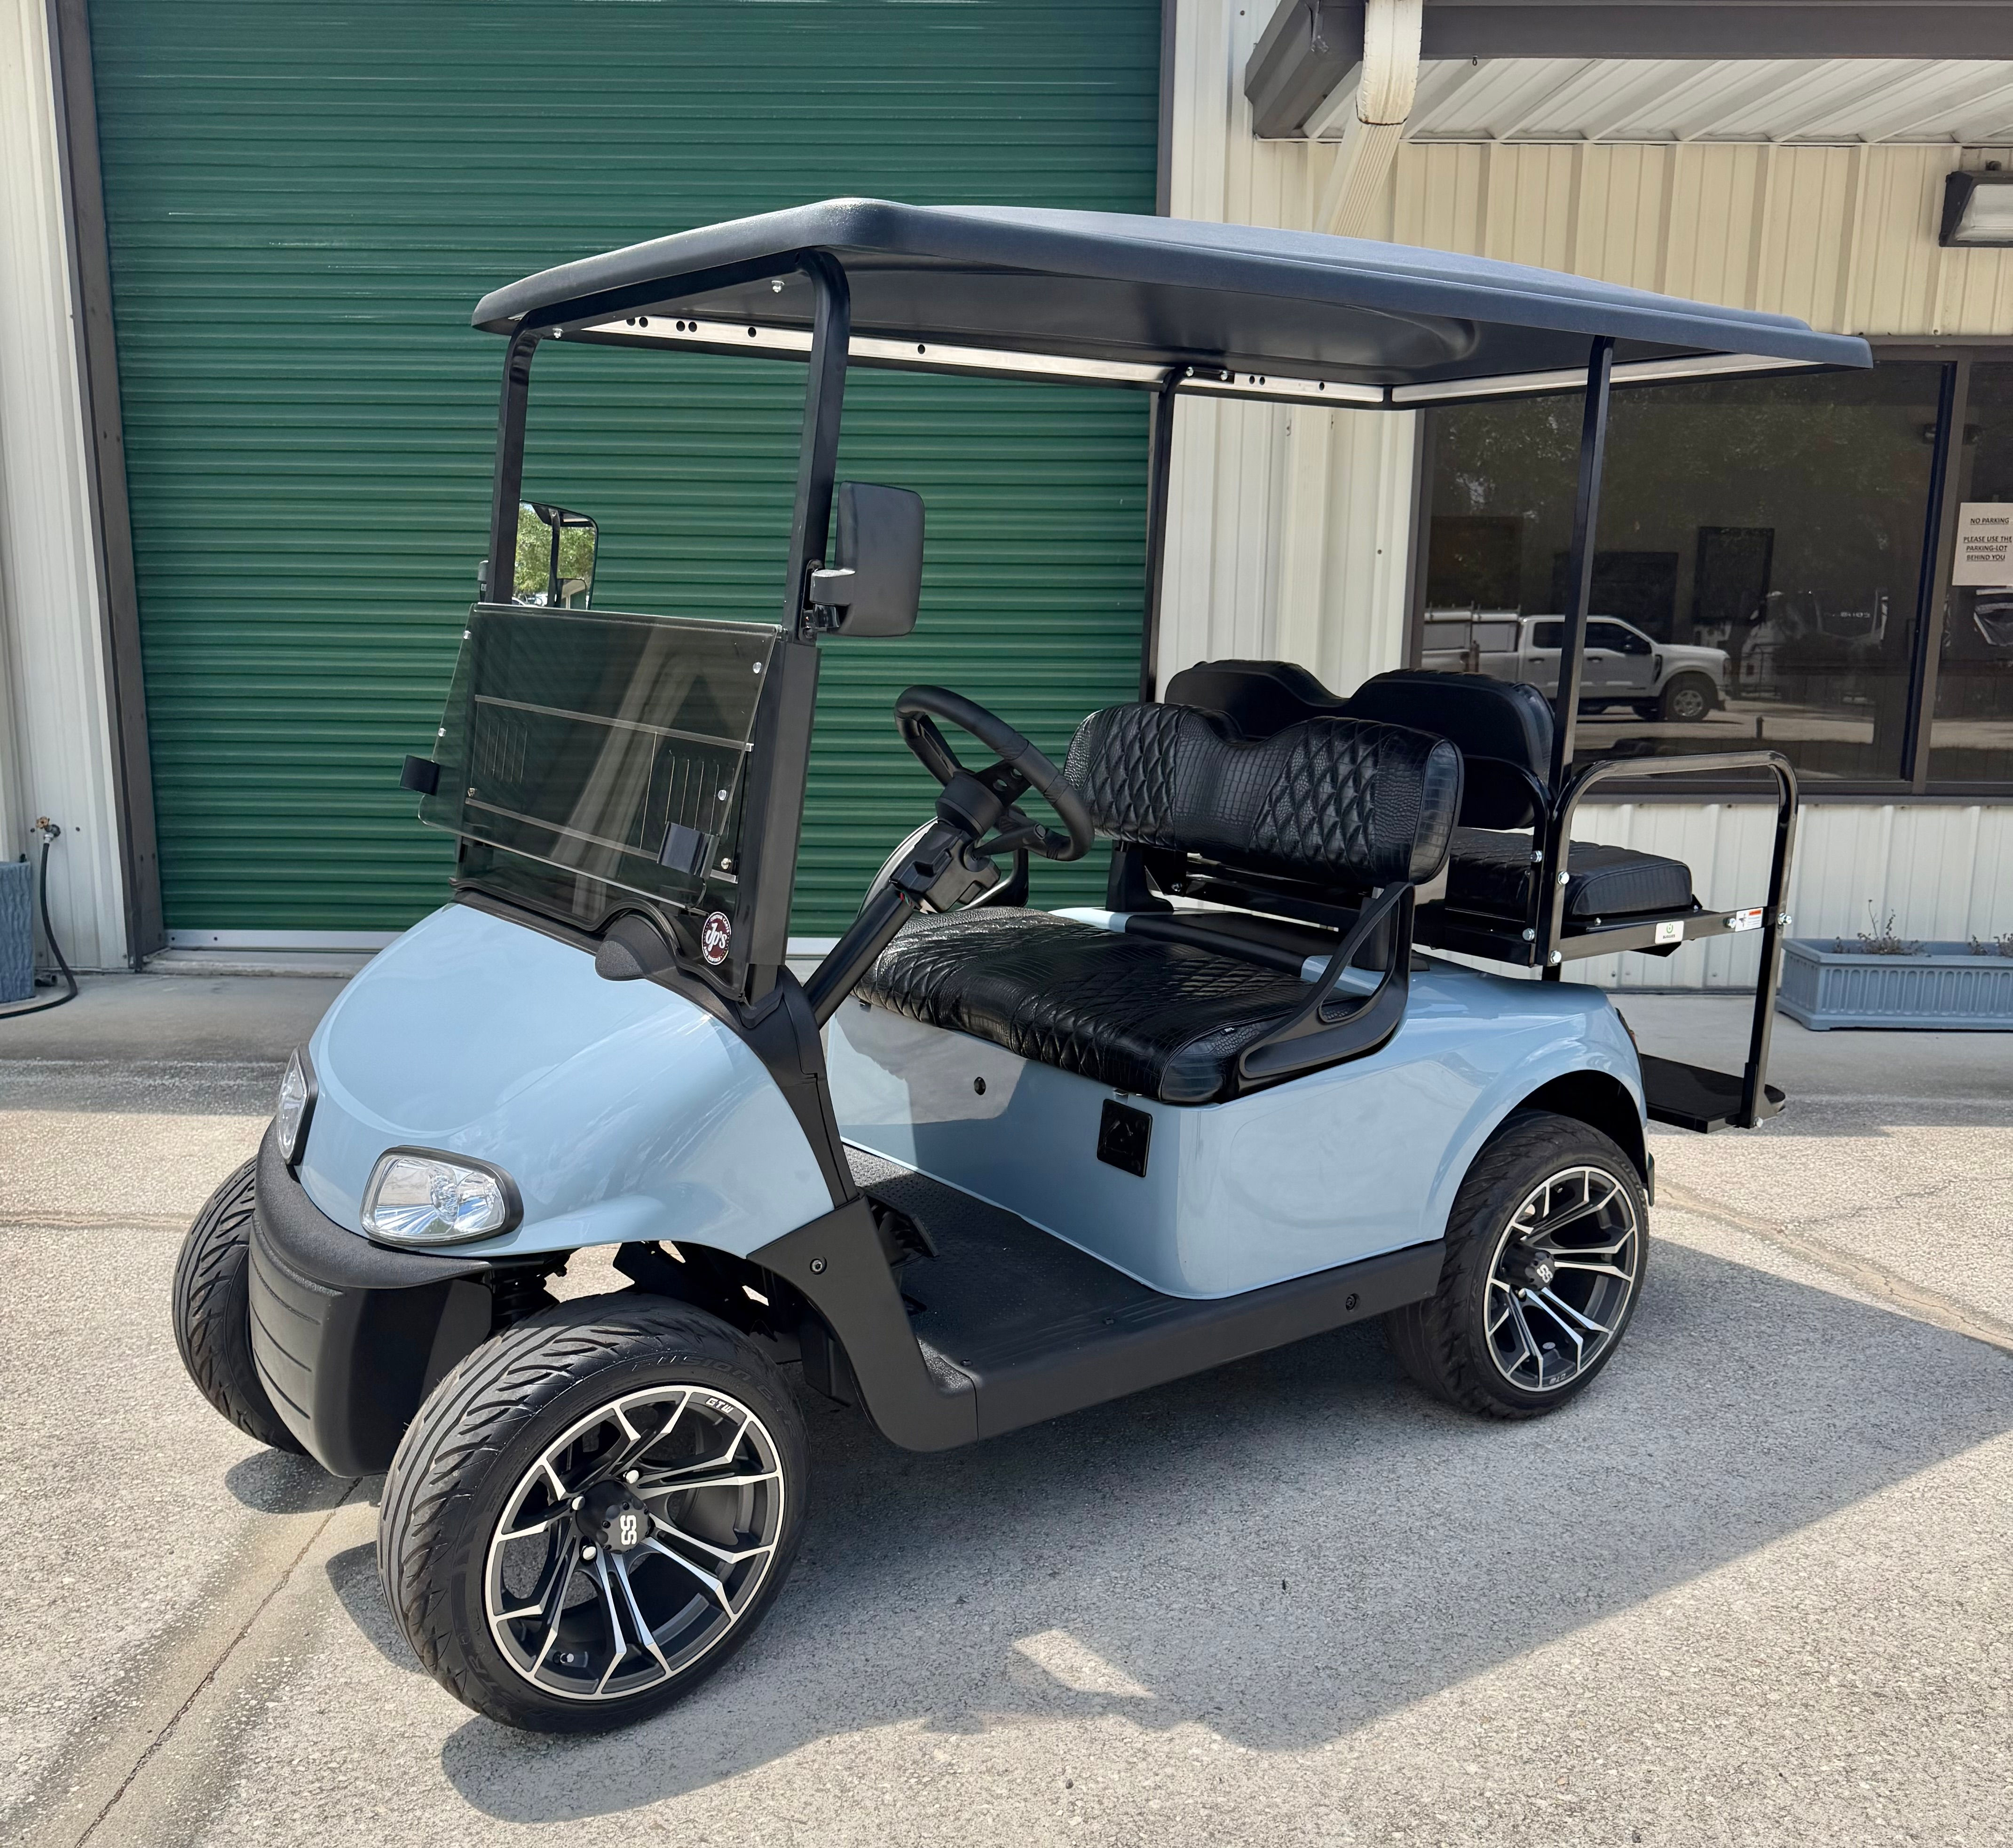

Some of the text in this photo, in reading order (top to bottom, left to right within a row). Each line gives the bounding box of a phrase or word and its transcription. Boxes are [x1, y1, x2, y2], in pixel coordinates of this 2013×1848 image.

[1537, 1264, 1553, 1282] SS
[706, 1398, 734, 1414] GTW
[620, 1515, 637, 1545] SS
